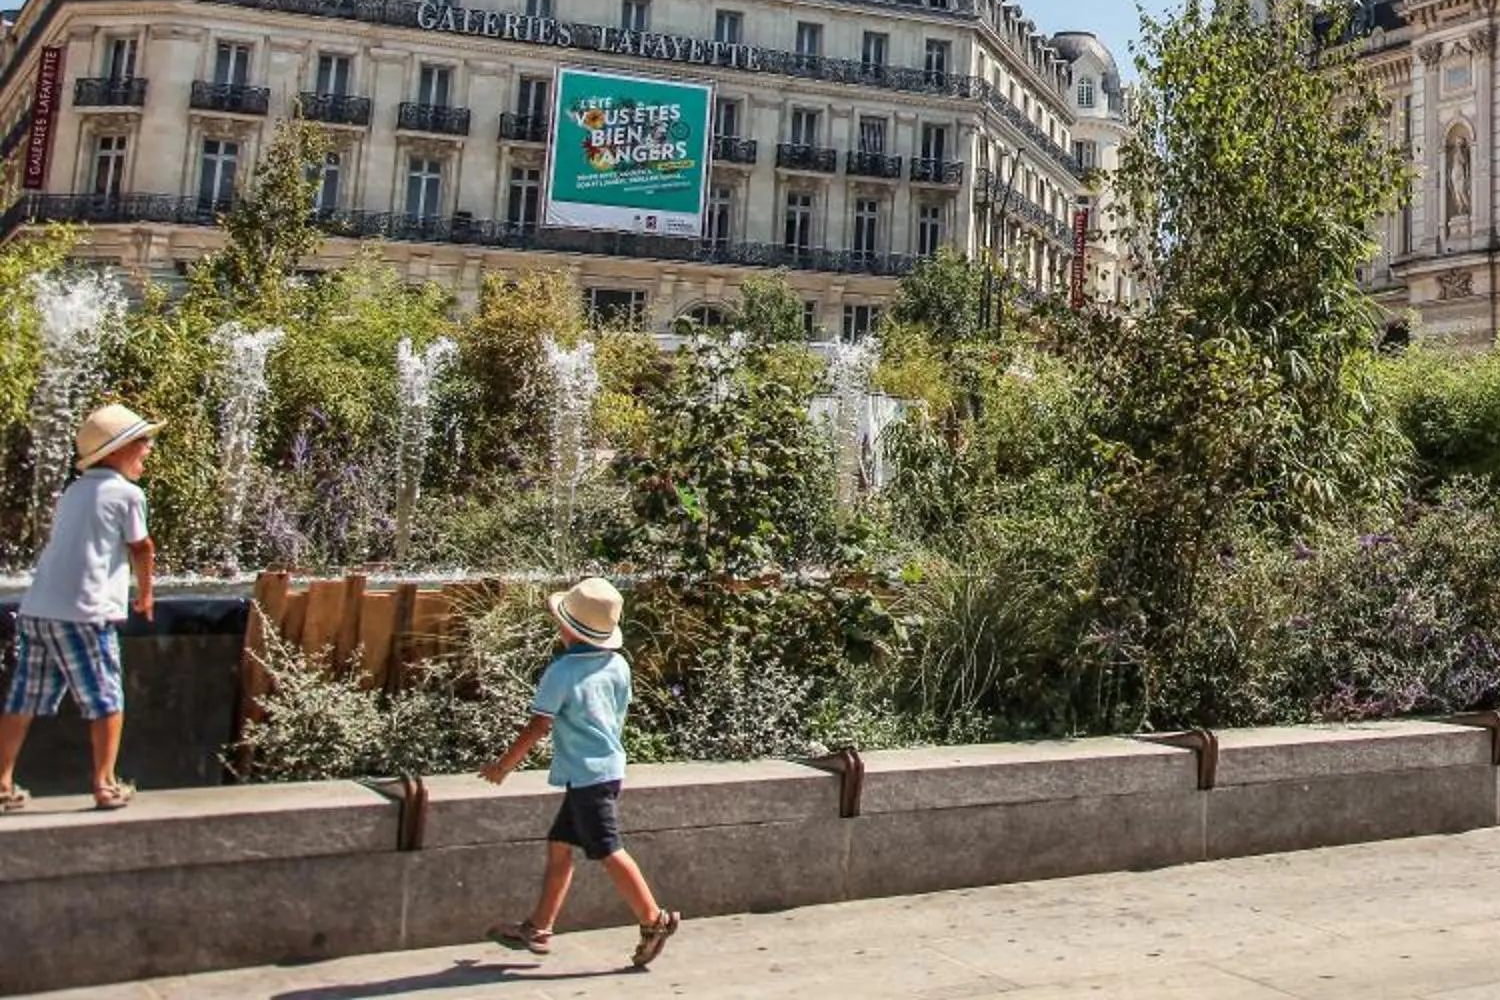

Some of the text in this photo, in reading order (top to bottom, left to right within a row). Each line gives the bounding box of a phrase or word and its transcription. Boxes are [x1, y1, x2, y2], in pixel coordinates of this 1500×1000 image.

[417, 1, 763, 70] GALERIES LAFAYETTE
[29, 50, 57, 176] GALERIES LAFAYETTE
[634, 102, 681, 124] ÊTES
[591, 125, 642, 147] BIEN
[601, 141, 687, 165] ANGERS
